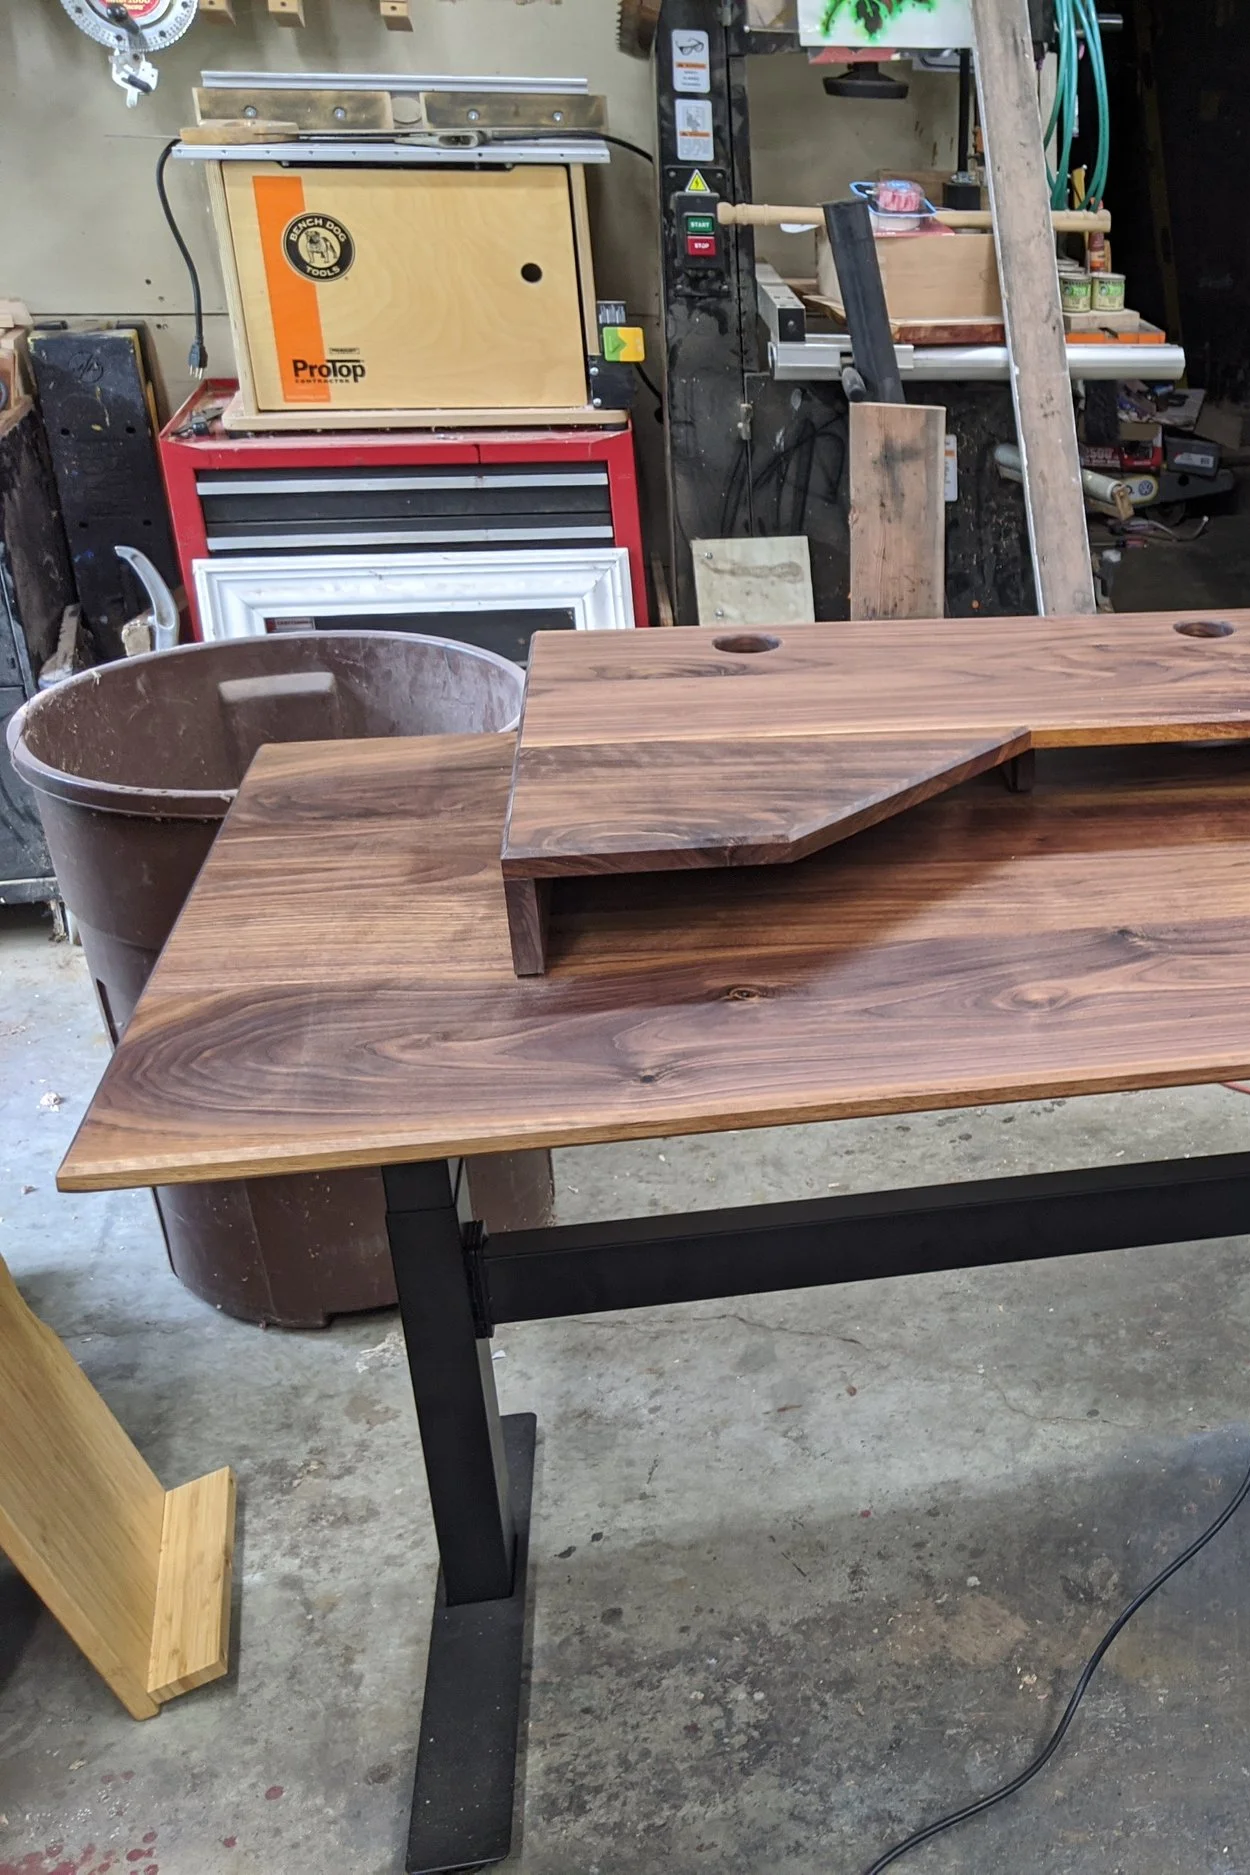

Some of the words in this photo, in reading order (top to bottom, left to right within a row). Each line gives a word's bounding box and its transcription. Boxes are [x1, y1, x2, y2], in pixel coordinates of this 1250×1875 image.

[290, 218, 323, 241] BENCH
[326, 220, 347, 242] DOG
[306, 265, 340, 277] TOOLS
[292, 359, 366, 383] ProTop
